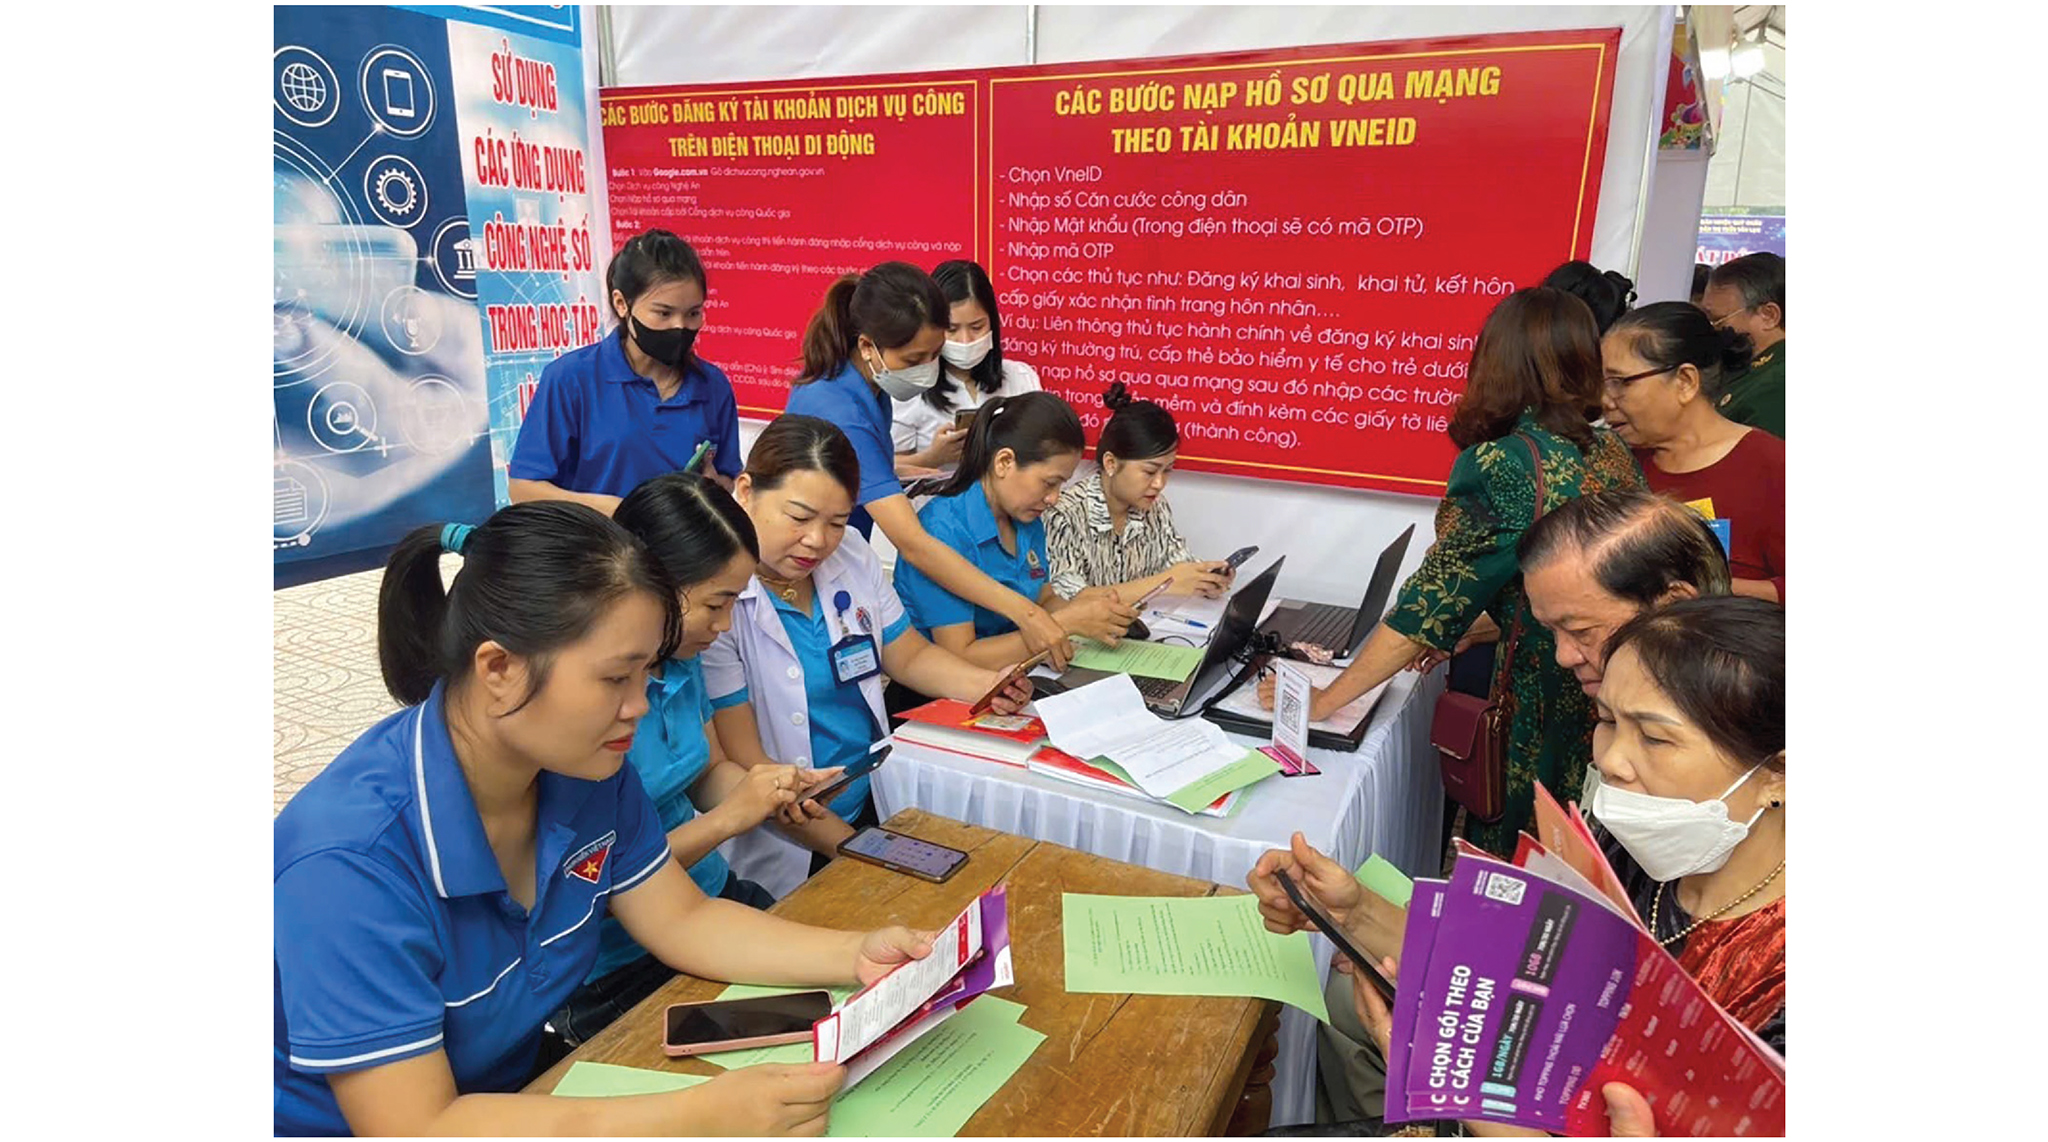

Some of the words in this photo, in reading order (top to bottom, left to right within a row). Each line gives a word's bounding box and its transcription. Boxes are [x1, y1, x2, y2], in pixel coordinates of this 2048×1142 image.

[491, 38, 513, 104] SỬ
[513, 56, 557, 118] DỤNG
[1056, 85, 1102, 116] CÁC
[1109, 81, 1176, 114] BƯỚC
[1183, 82, 1238, 115] NẠP
[1245, 69, 1282, 108] HỒ
[1290, 73, 1331, 105] SƠ
[1338, 72, 1394, 105] QUA
[1404, 66, 1502, 104] MẠNG
[600, 102, 626, 126] CÁC
[629, 100, 669, 126] BƯỚC
[672, 98, 716, 124] ĐĂNG
[719, 96, 739, 122] KÝ
[743, 95, 769, 121] TÀI
[773, 90, 832, 120] KHOẢN
[836, 95, 878, 123] DỊCH
[883, 94, 908, 122] VỤ
[912, 88, 966, 116] CÔNG
[668, 132, 708, 157] TRÊN
[712, 131, 749, 161] ĐIỆN
[752, 134, 800, 160] THOẠI
[804, 134, 822, 156] DI
[826, 128, 876, 161] ĐỘNG
[1111, 126, 1172, 154] THEO
[1180, 120, 1220, 152] TÀI
[1226, 112, 1321, 150] KHOẢN
[1329, 117, 1417, 147] VNEID
[475, 128, 507, 188] CÁC
[511, 131, 542, 190] ỨNG
[543, 147, 586, 203] DỤNG
[1008, 166, 1050, 185] Chọn
[1054, 166, 1102, 182] VneID
[735, 208, 754, 219] công
[755, 207, 776, 218] Quốc
[1008, 192, 1050, 210] Nhập
[1054, 190, 1073, 208] số
[1075, 192, 1110, 208] Căn
[1114, 190, 1156, 208] cước
[1160, 190, 1206, 212] công
[1211, 190, 1248, 207] dân
[1008, 217, 1050, 236] Nhập
[1054, 217, 1084, 236] Mật
[1088, 213, 1128, 234] khẩu
[1132, 217, 1184, 238] (Trong
[1188, 217, 1226, 237] điện
[1232, 217, 1278, 238] thoại
[1282, 216, 1302, 235] sẽ
[1307, 216, 1334, 235] có
[1338, 218, 1372, 235] mã
[1376, 217, 1424, 239] OTP)
[485, 212, 527, 271] CÔNG
[527, 220, 569, 281] NGHỆ
[572, 213, 592, 272] SỐ
[906, 240, 930, 252] công
[930, 240, 942, 251] và
[1008, 242, 1050, 260] Nhập
[1054, 243, 1080, 259] mã
[1082, 242, 1114, 258] OTP
[1008, 266, 1049, 283] Chọn
[1052, 267, 1084, 283] các
[1088, 266, 1113, 284] thủ
[1116, 269, 1143, 288] tục
[1147, 270, 1183, 286] như:
[1187, 270, 1236, 291] Đăng
[1240, 271, 1260, 292] ký
[1264, 272, 1302, 290] khai
[1306, 272, 1346, 292] sinh,
[1358, 274, 1398, 292] khai
[1404, 273, 1428, 294] tử,
[1435, 274, 1468, 294] kết
[1473, 276, 1516, 295] hôn
[1000, 288, 1030, 307] cấp
[1033, 290, 1064, 310] giấy
[1068, 292, 1097, 308] xác
[1101, 294, 1142, 312] nhận
[1146, 295, 1176, 312] tình
[1230, 297, 1264, 314] hôn
[487, 304, 540, 353] TRONG
[540, 304, 569, 356] HỌC
[1000, 314, 1012, 328] Ví
[1016, 316, 1040, 332] dụ:
[1044, 316, 1073, 332] Liên
[1076, 318, 1122, 338] thông
[1126, 318, 1152, 336] thủ
[1156, 322, 1183, 338] tục
[1188, 322, 1232, 339] hành
[1236, 324, 1285, 341] chính
[1290, 324, 1313, 344] về
[1318, 328, 1369, 350] đăng
[1374, 330, 1396, 350] ký
[1401, 331, 1443, 350] khai
[1000, 338, 1038, 356] đăng
[1041, 340, 1057, 356] ký
[1060, 340, 1116, 361] thường
[1148, 344, 1182, 364] cấp
[1187, 346, 1214, 364] thẻ
[1218, 348, 1255, 366] bảo
[1258, 347, 1303, 368] hiểm
[1308, 357, 1320, 373] y
[1324, 354, 1344, 371] tế
[1348, 356, 1386, 374] cho
[1392, 357, 1418, 376] trẻ
[1422, 360, 1469, 379] dưới
[1041, 366, 1072, 380] nạp
[1075, 363, 1096, 381] hồ
[1099, 368, 1116, 382] sơ
[1119, 371, 1152, 386] qua
[1155, 372, 1188, 388] qua
[1192, 374, 1244, 395] mạng
[1248, 378, 1278, 394] sau
[1283, 378, 1308, 396] đó
[1312, 381, 1364, 402] nhập
[1368, 384, 1408, 402] các
[1065, 390, 1104, 408] trong
[1154, 394, 1196, 412] mềm
[1200, 398, 1222, 415] và
[1226, 400, 1264, 418] đính
[1268, 404, 1306, 420] kèm
[1311, 407, 1350, 425] các
[1354, 408, 1396, 431] giấy
[1401, 412, 1421, 431] tờ
[1426, 415, 1448, 433] liê
[1079, 413, 1100, 428] đó
[1184, 421, 1240, 440] (thành
[1244, 427, 1301, 449] công).
[1446, 965, 1472, 1008] THEO
[1472, 977, 1497, 1010] BẠN
[1438, 1010, 1460, 1040] GÓI
[1461, 1011, 1485, 1044] CỦA
[1430, 1041, 1454, 1088] CHỌN
[1452, 1044, 1477, 1090] CÁCH
